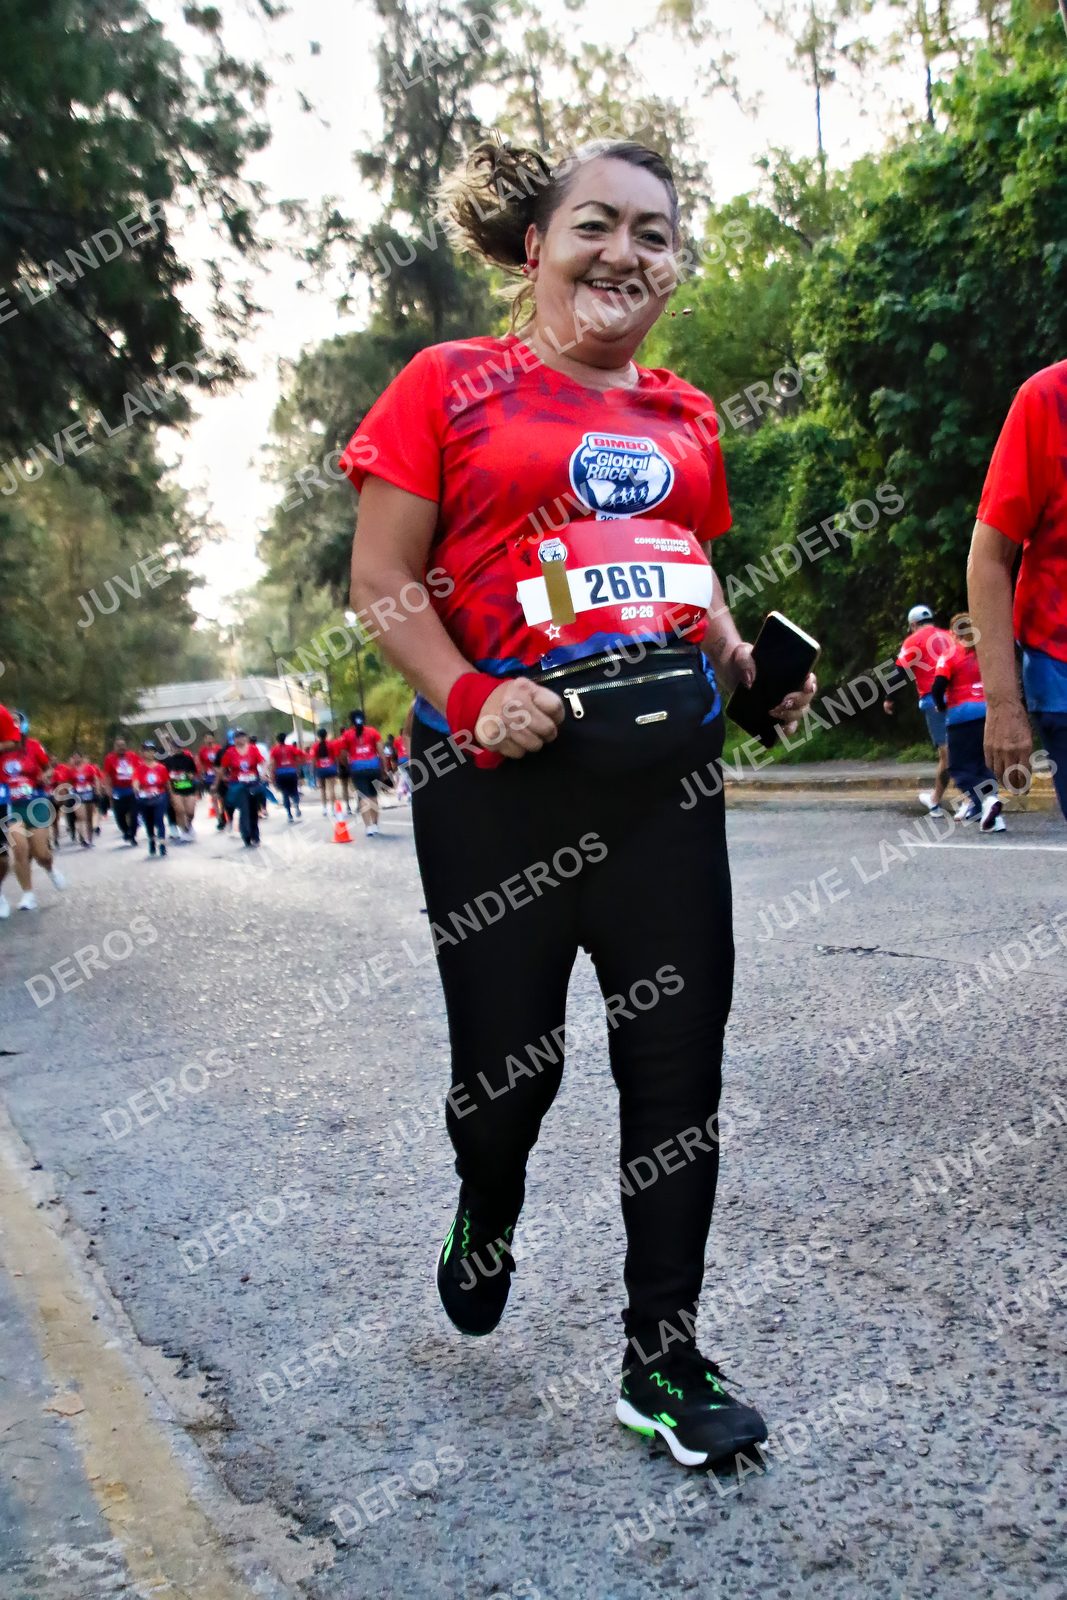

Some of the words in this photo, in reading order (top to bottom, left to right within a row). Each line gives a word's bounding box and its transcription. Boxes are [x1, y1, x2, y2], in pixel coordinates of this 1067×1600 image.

[593, 438, 649, 451] BIMBO
[596, 452, 649, 470] Global
[586, 463, 630, 481] Race
[584, 565, 666, 604] 2667
